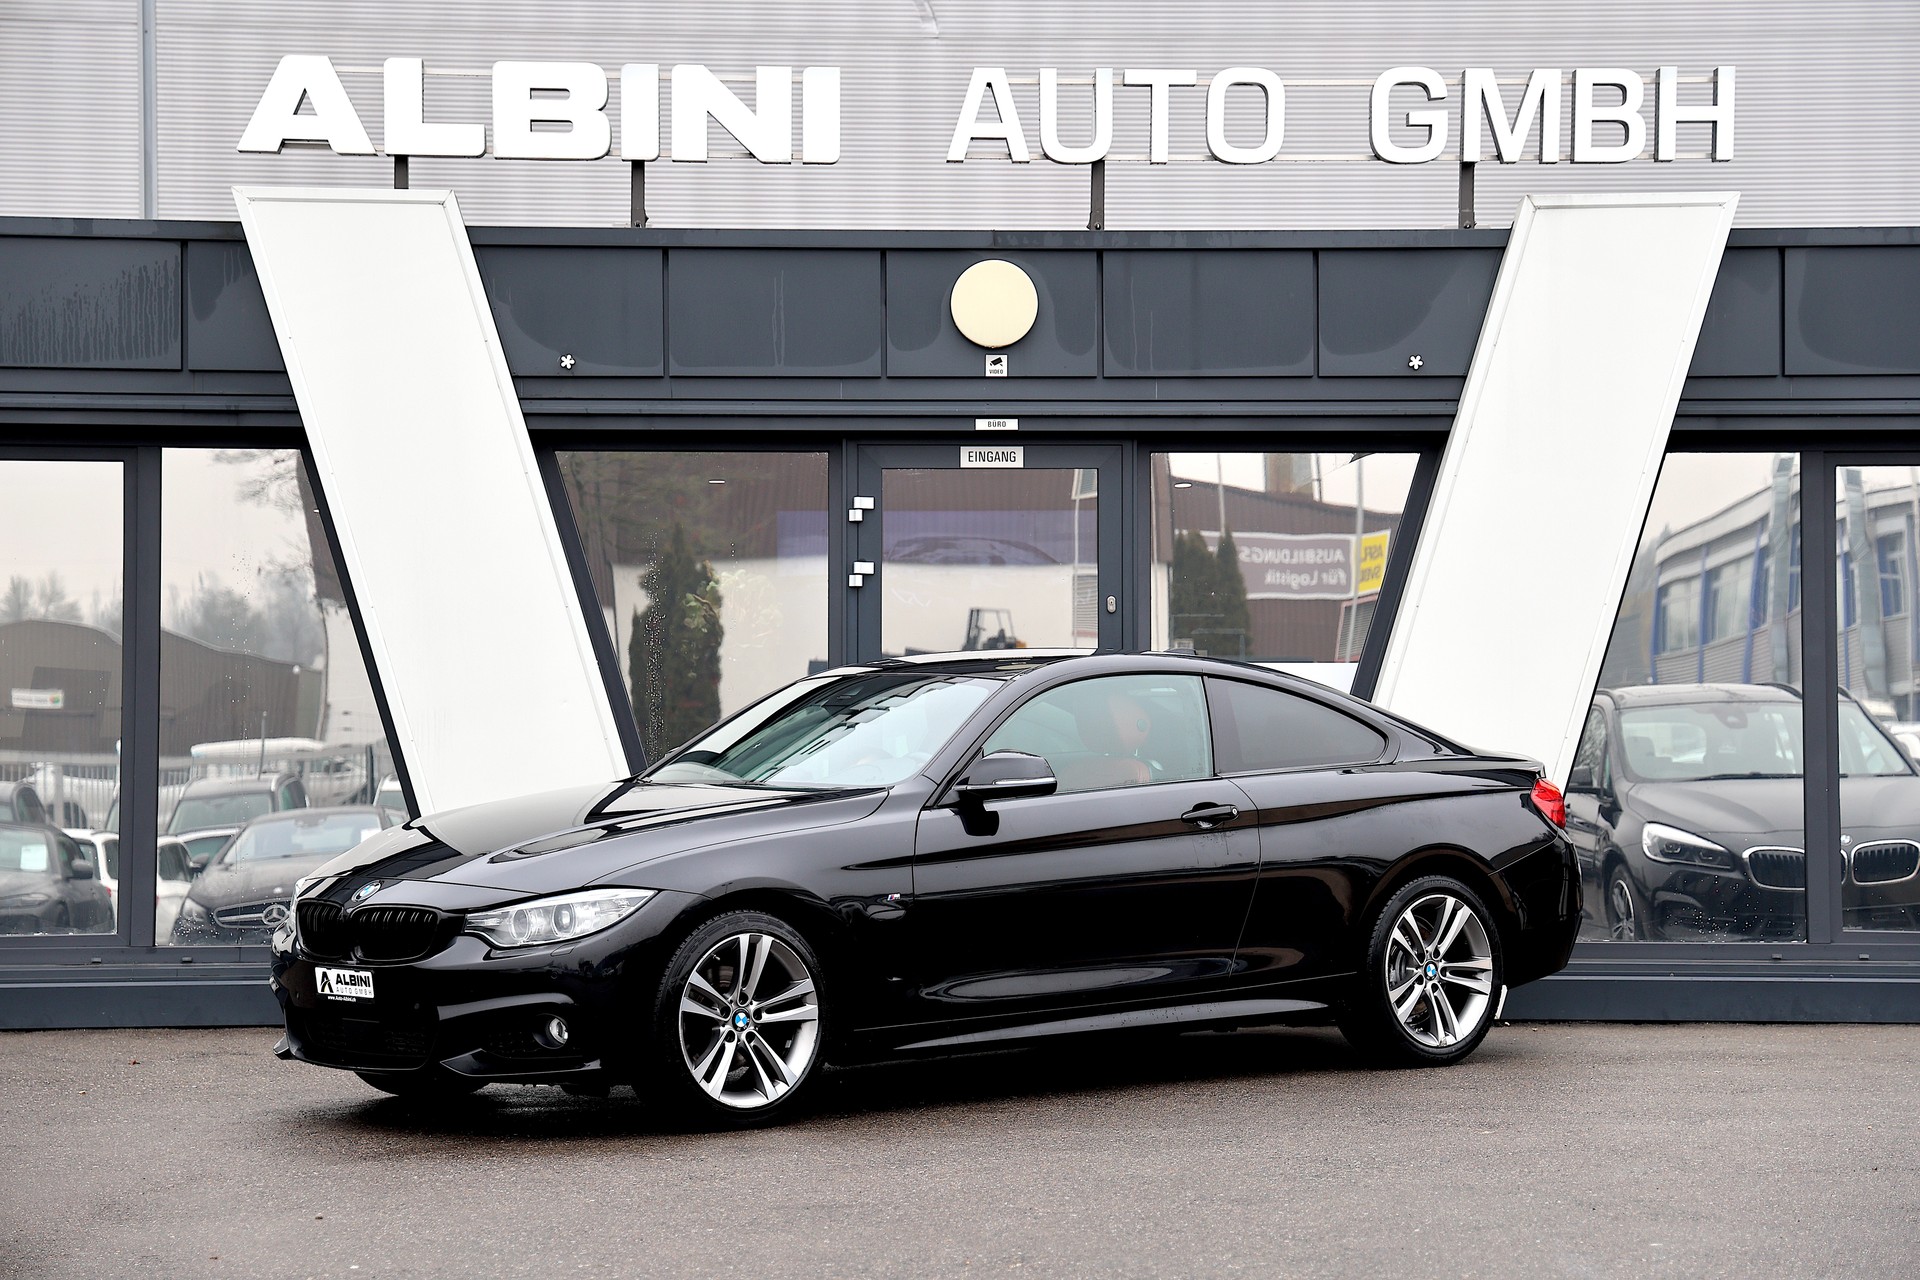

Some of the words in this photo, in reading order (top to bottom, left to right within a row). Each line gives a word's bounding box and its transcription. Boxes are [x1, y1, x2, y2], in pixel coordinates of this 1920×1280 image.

[238, 54, 841, 164] ALBINI
[946, 67, 1286, 164] AUTO
[1369, 66, 1736, 164] GMBH
[968, 451, 1016, 462] EINGANG
[336, 973, 371, 987] ALBINI
